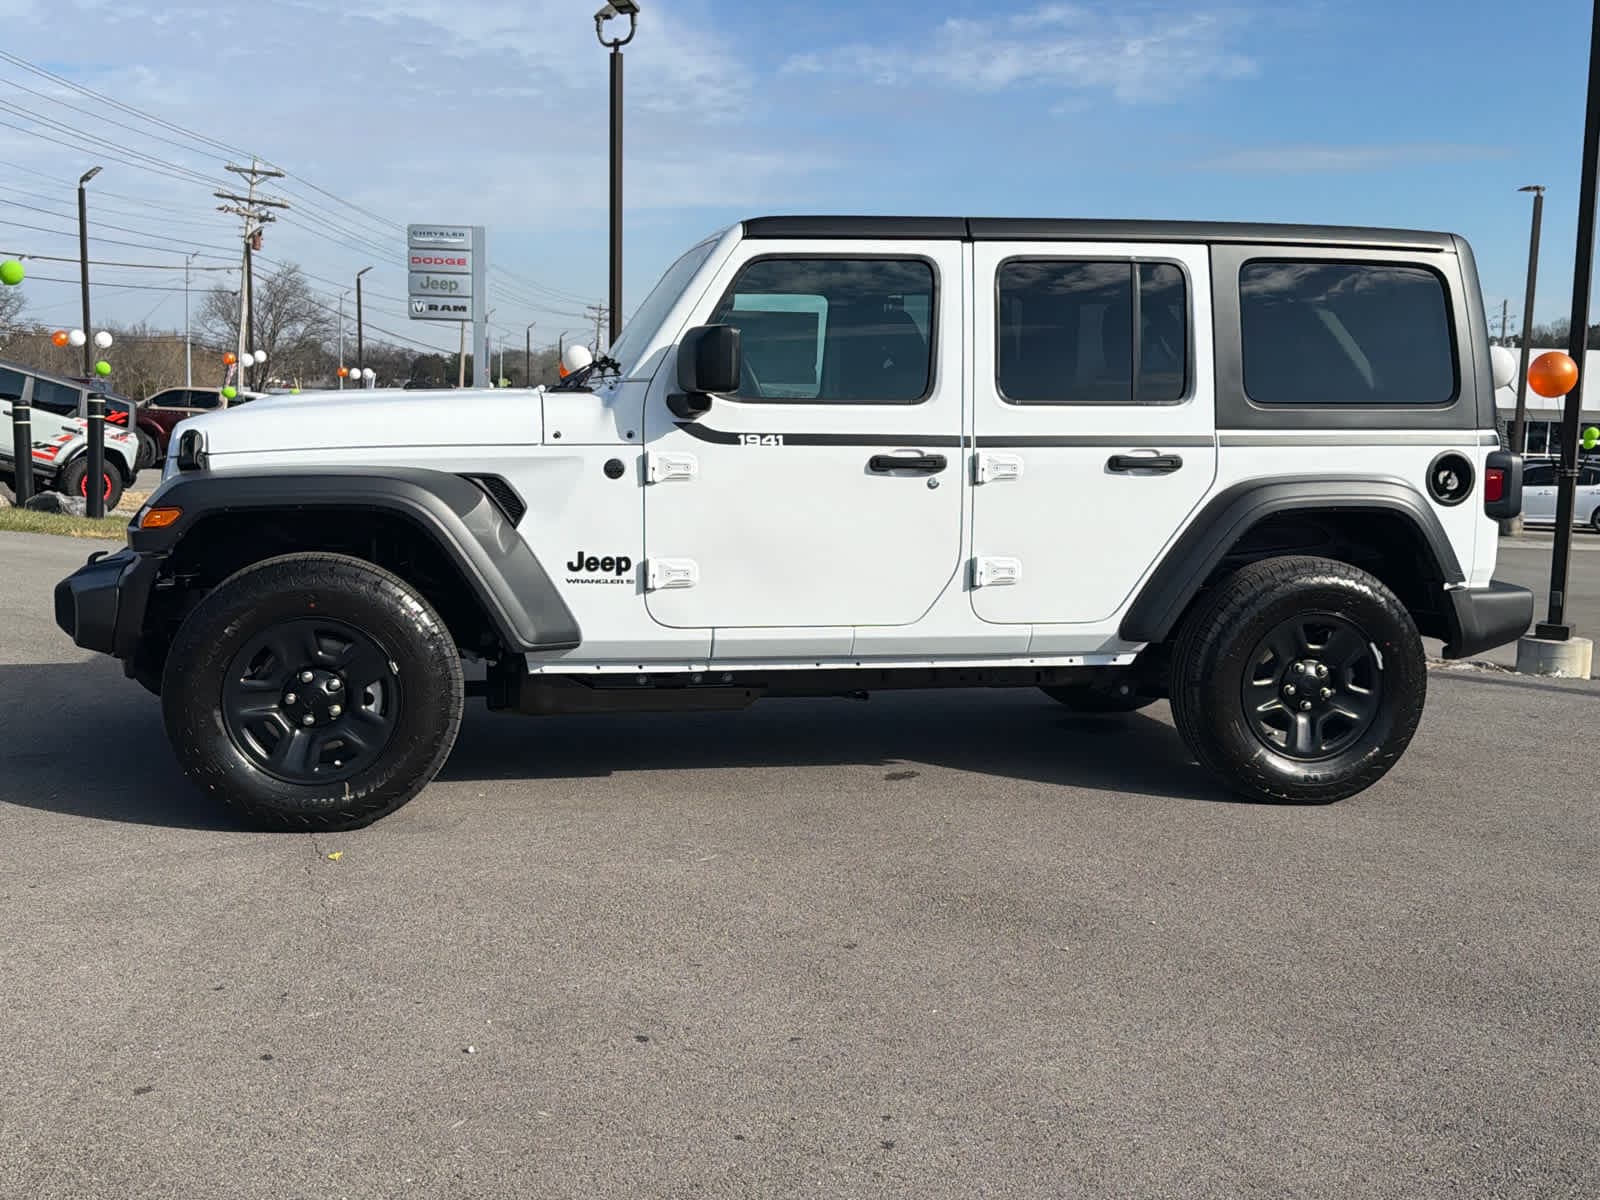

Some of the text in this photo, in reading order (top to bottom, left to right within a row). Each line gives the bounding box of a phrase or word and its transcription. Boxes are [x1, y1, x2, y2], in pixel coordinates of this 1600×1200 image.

[411, 256, 467, 266] DODGE
[420, 276, 459, 293] Jeep
[428, 304, 467, 312] RAM
[737, 434, 784, 447] 1941
[566, 551, 632, 576] Jeep
